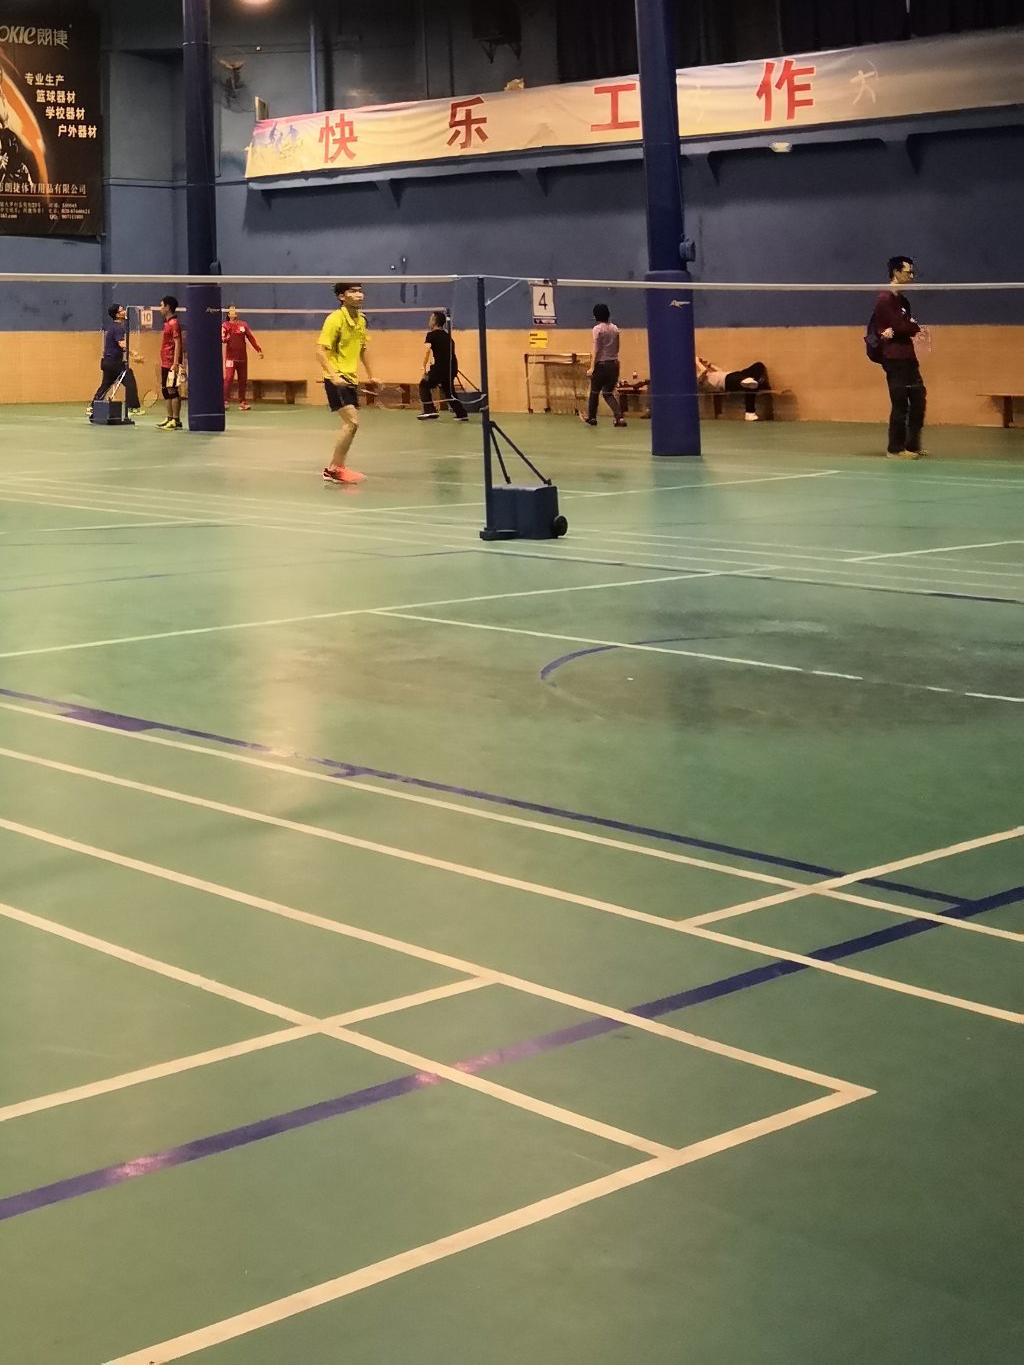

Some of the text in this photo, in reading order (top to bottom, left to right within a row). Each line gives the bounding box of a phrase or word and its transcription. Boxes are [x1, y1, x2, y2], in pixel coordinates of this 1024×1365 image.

[25, 72, 65, 87] 专业生产
[36, 89, 76, 104] 篮球器材
[45, 106, 85, 120] 学校器材
[58, 124, 97, 138] 户外器材
[538, 292, 548, 310] 4
[142, 312, 151, 322] 10
